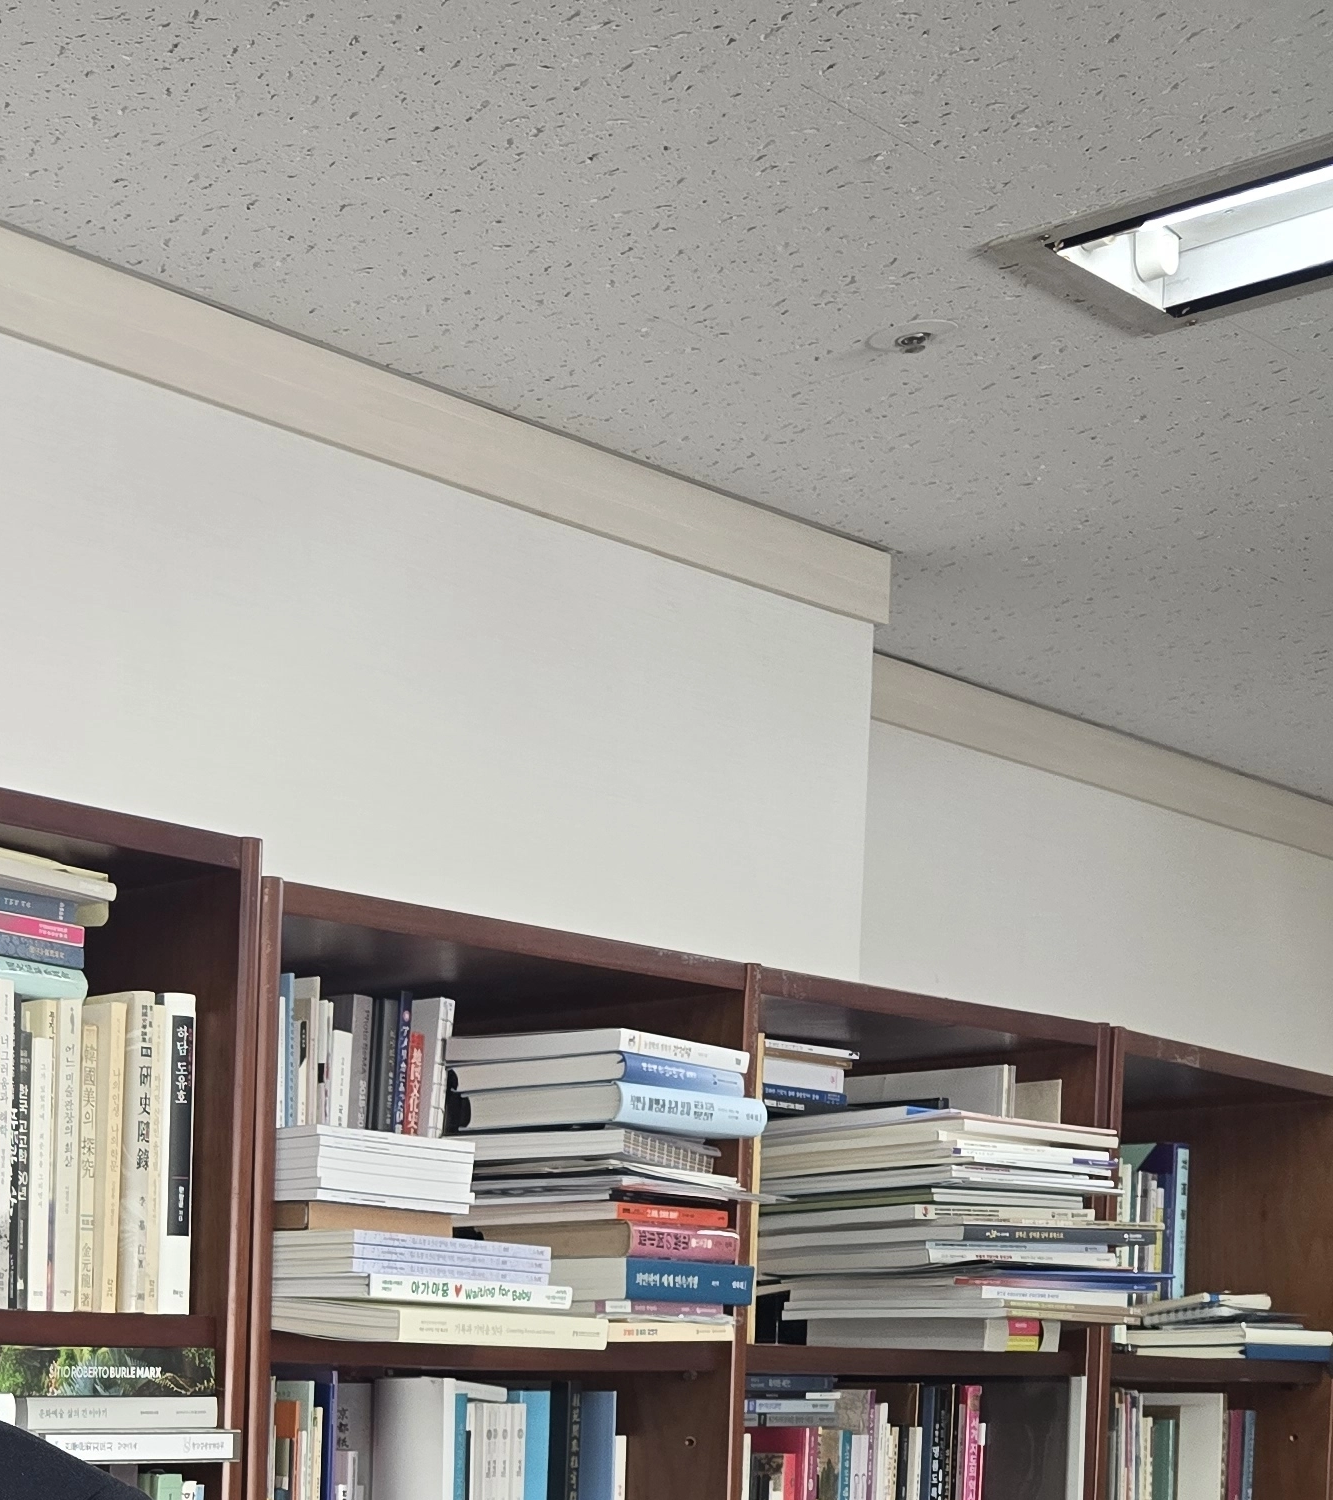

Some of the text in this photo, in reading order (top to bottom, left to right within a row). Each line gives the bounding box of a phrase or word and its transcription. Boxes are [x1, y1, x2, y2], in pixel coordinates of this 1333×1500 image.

[464, 1287, 532, 1302] Waiting for Baby
[109, 1366, 136, 1379] BURLE
[136, 1366, 162, 1379] MARX
